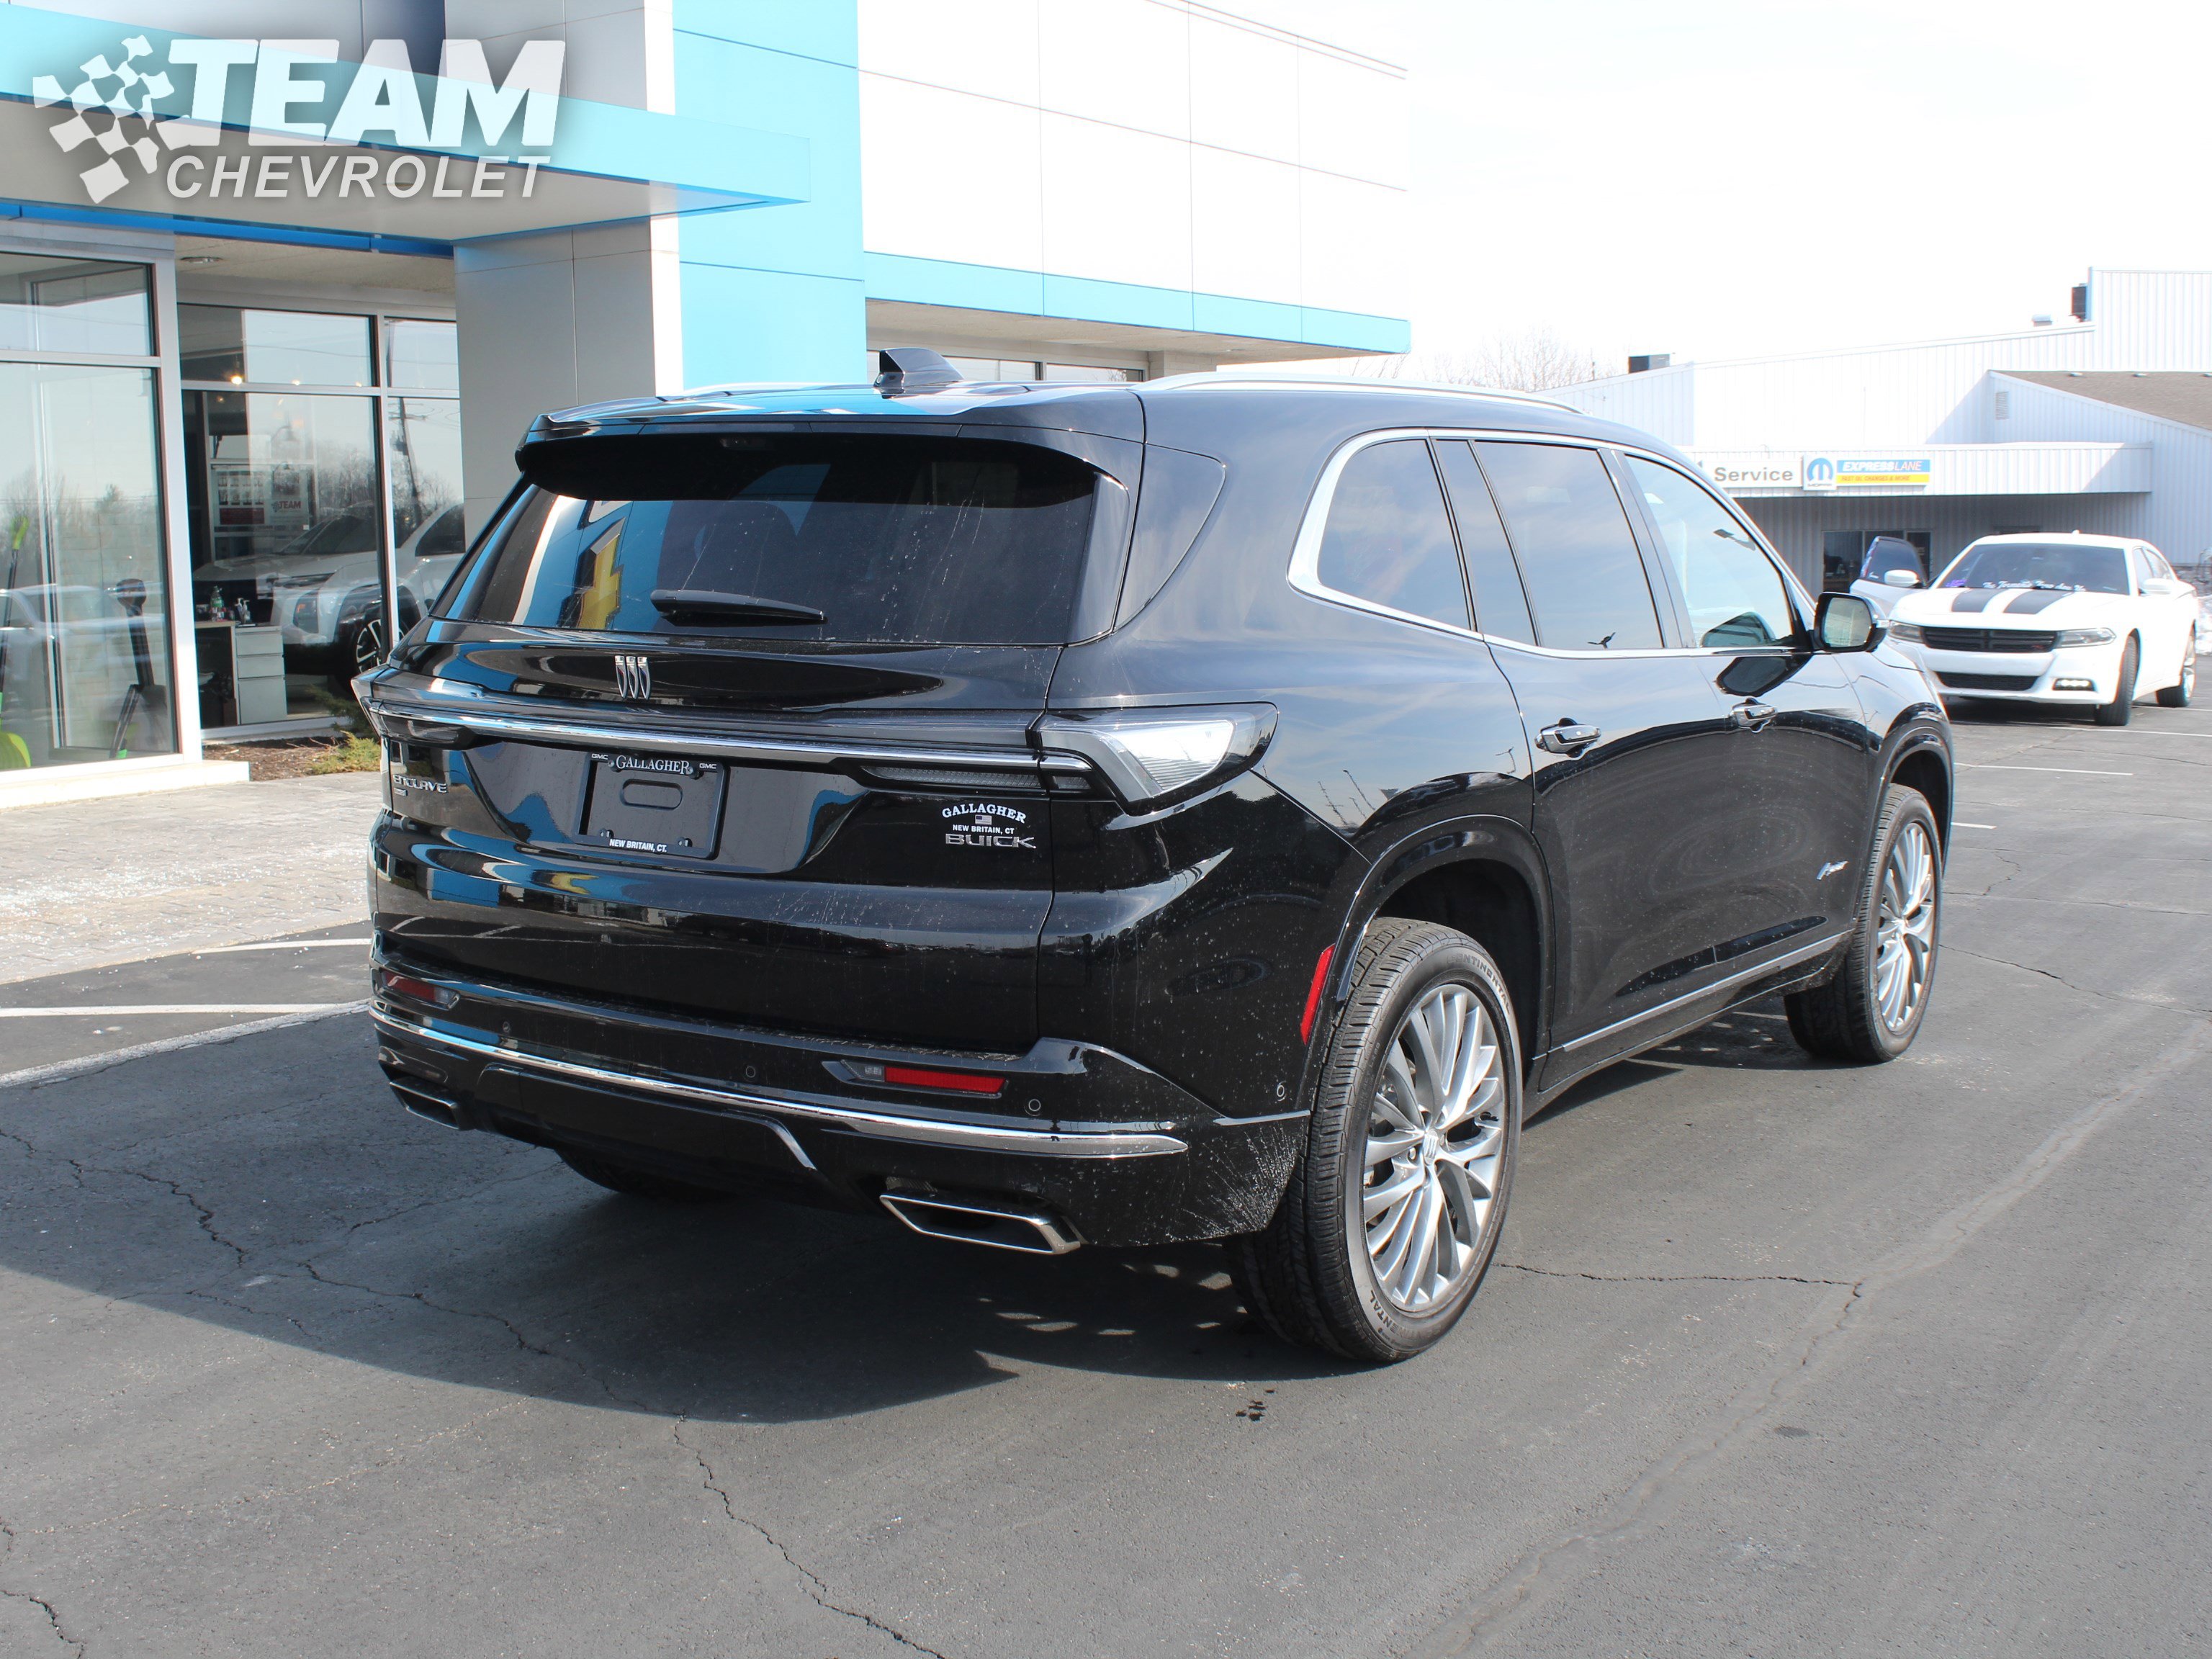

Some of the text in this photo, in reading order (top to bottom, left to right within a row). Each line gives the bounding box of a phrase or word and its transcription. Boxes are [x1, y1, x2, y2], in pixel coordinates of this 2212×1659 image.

[1714, 467, 1793, 482] Service
[616, 755, 689, 775] GALLAGHER
[393, 774, 448, 793] ENCLAVE
[942, 803, 1027, 824] GALLAGHER
[971, 826, 1003, 835] BRITAIN,
[609, 839, 667, 853] NEW BRITAIN, CT.
[945, 833, 1037, 849] BUICK
